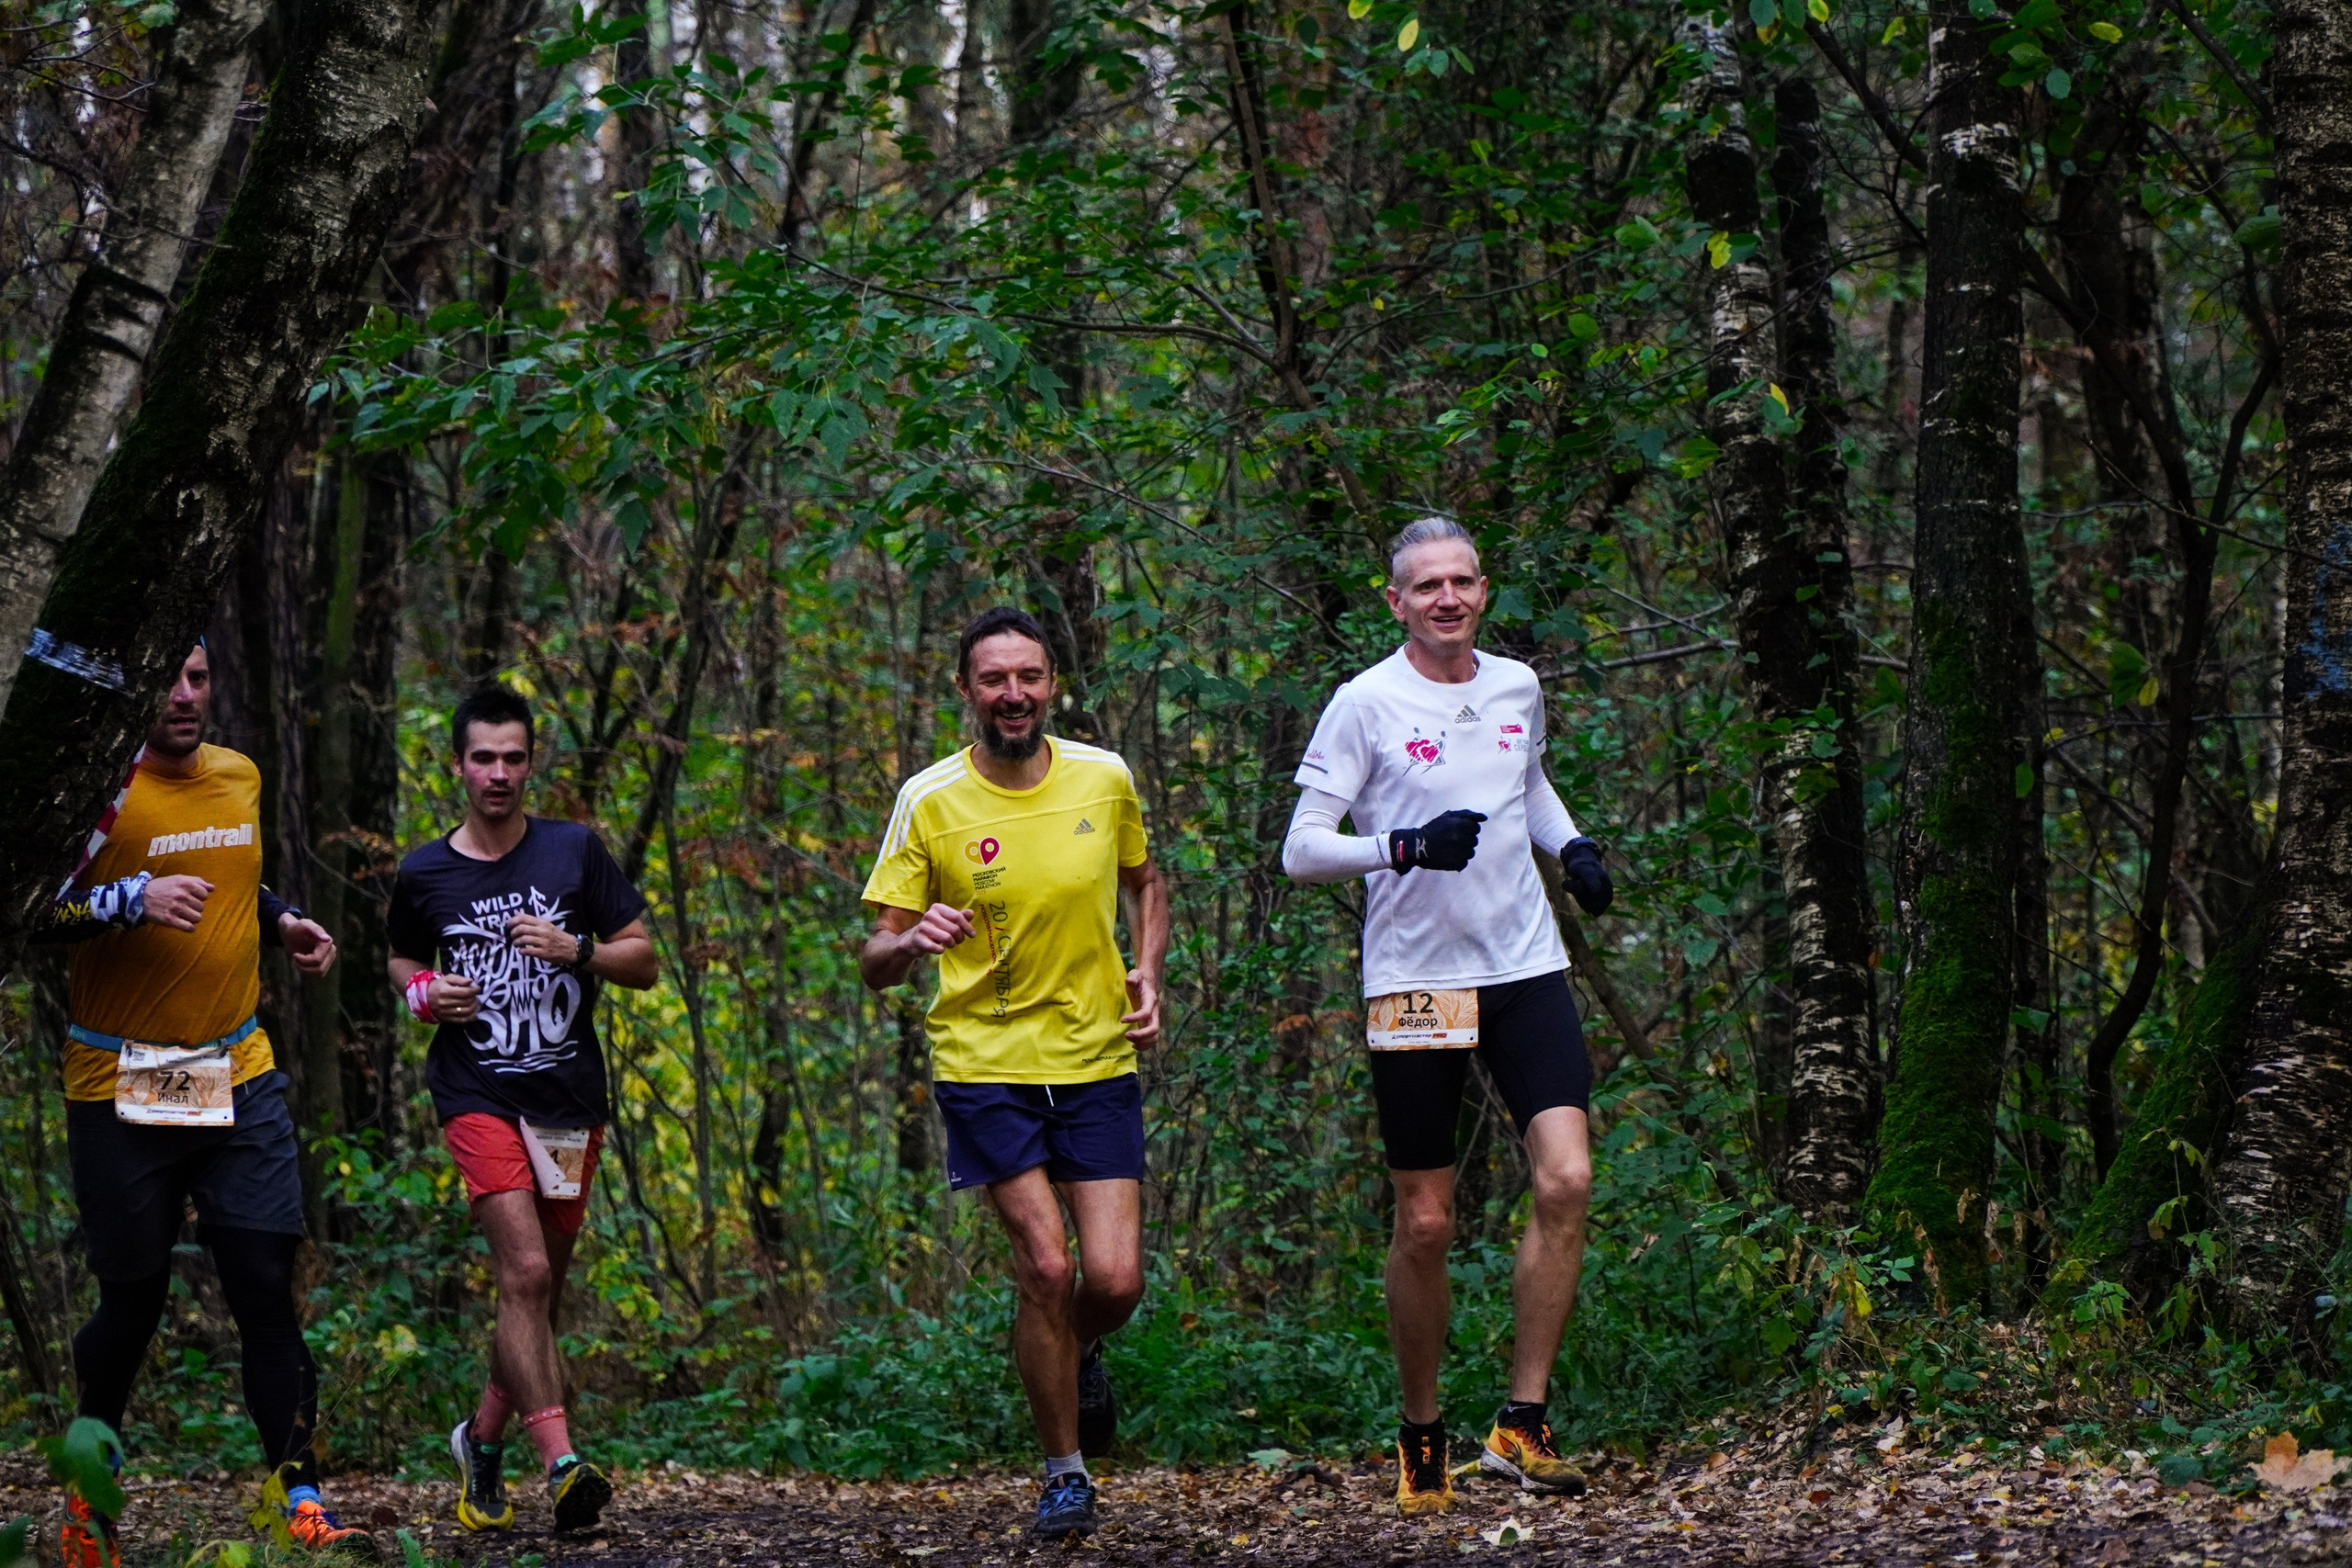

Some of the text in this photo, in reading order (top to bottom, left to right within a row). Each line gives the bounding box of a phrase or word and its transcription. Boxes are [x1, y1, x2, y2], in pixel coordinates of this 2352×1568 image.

[1454, 716, 1481, 724] adidas
[1073, 827, 1096, 835] adidas
[147, 823, 253, 857] montrail
[972, 866, 1007, 877] МОСКОВСКИЙ
[973, 873, 998, 882] МАРАФОН
[975, 882, 1001, 891] MARATHON
[470, 892, 524, 916] WILD
[989, 901, 1009, 922] 20
[1403, 992, 1434, 1014] 12
[1398, 1016, 1438, 1028] Фёдор
[160, 1070, 190, 1091] 72
[157, 1093, 188, 1104] Инал
